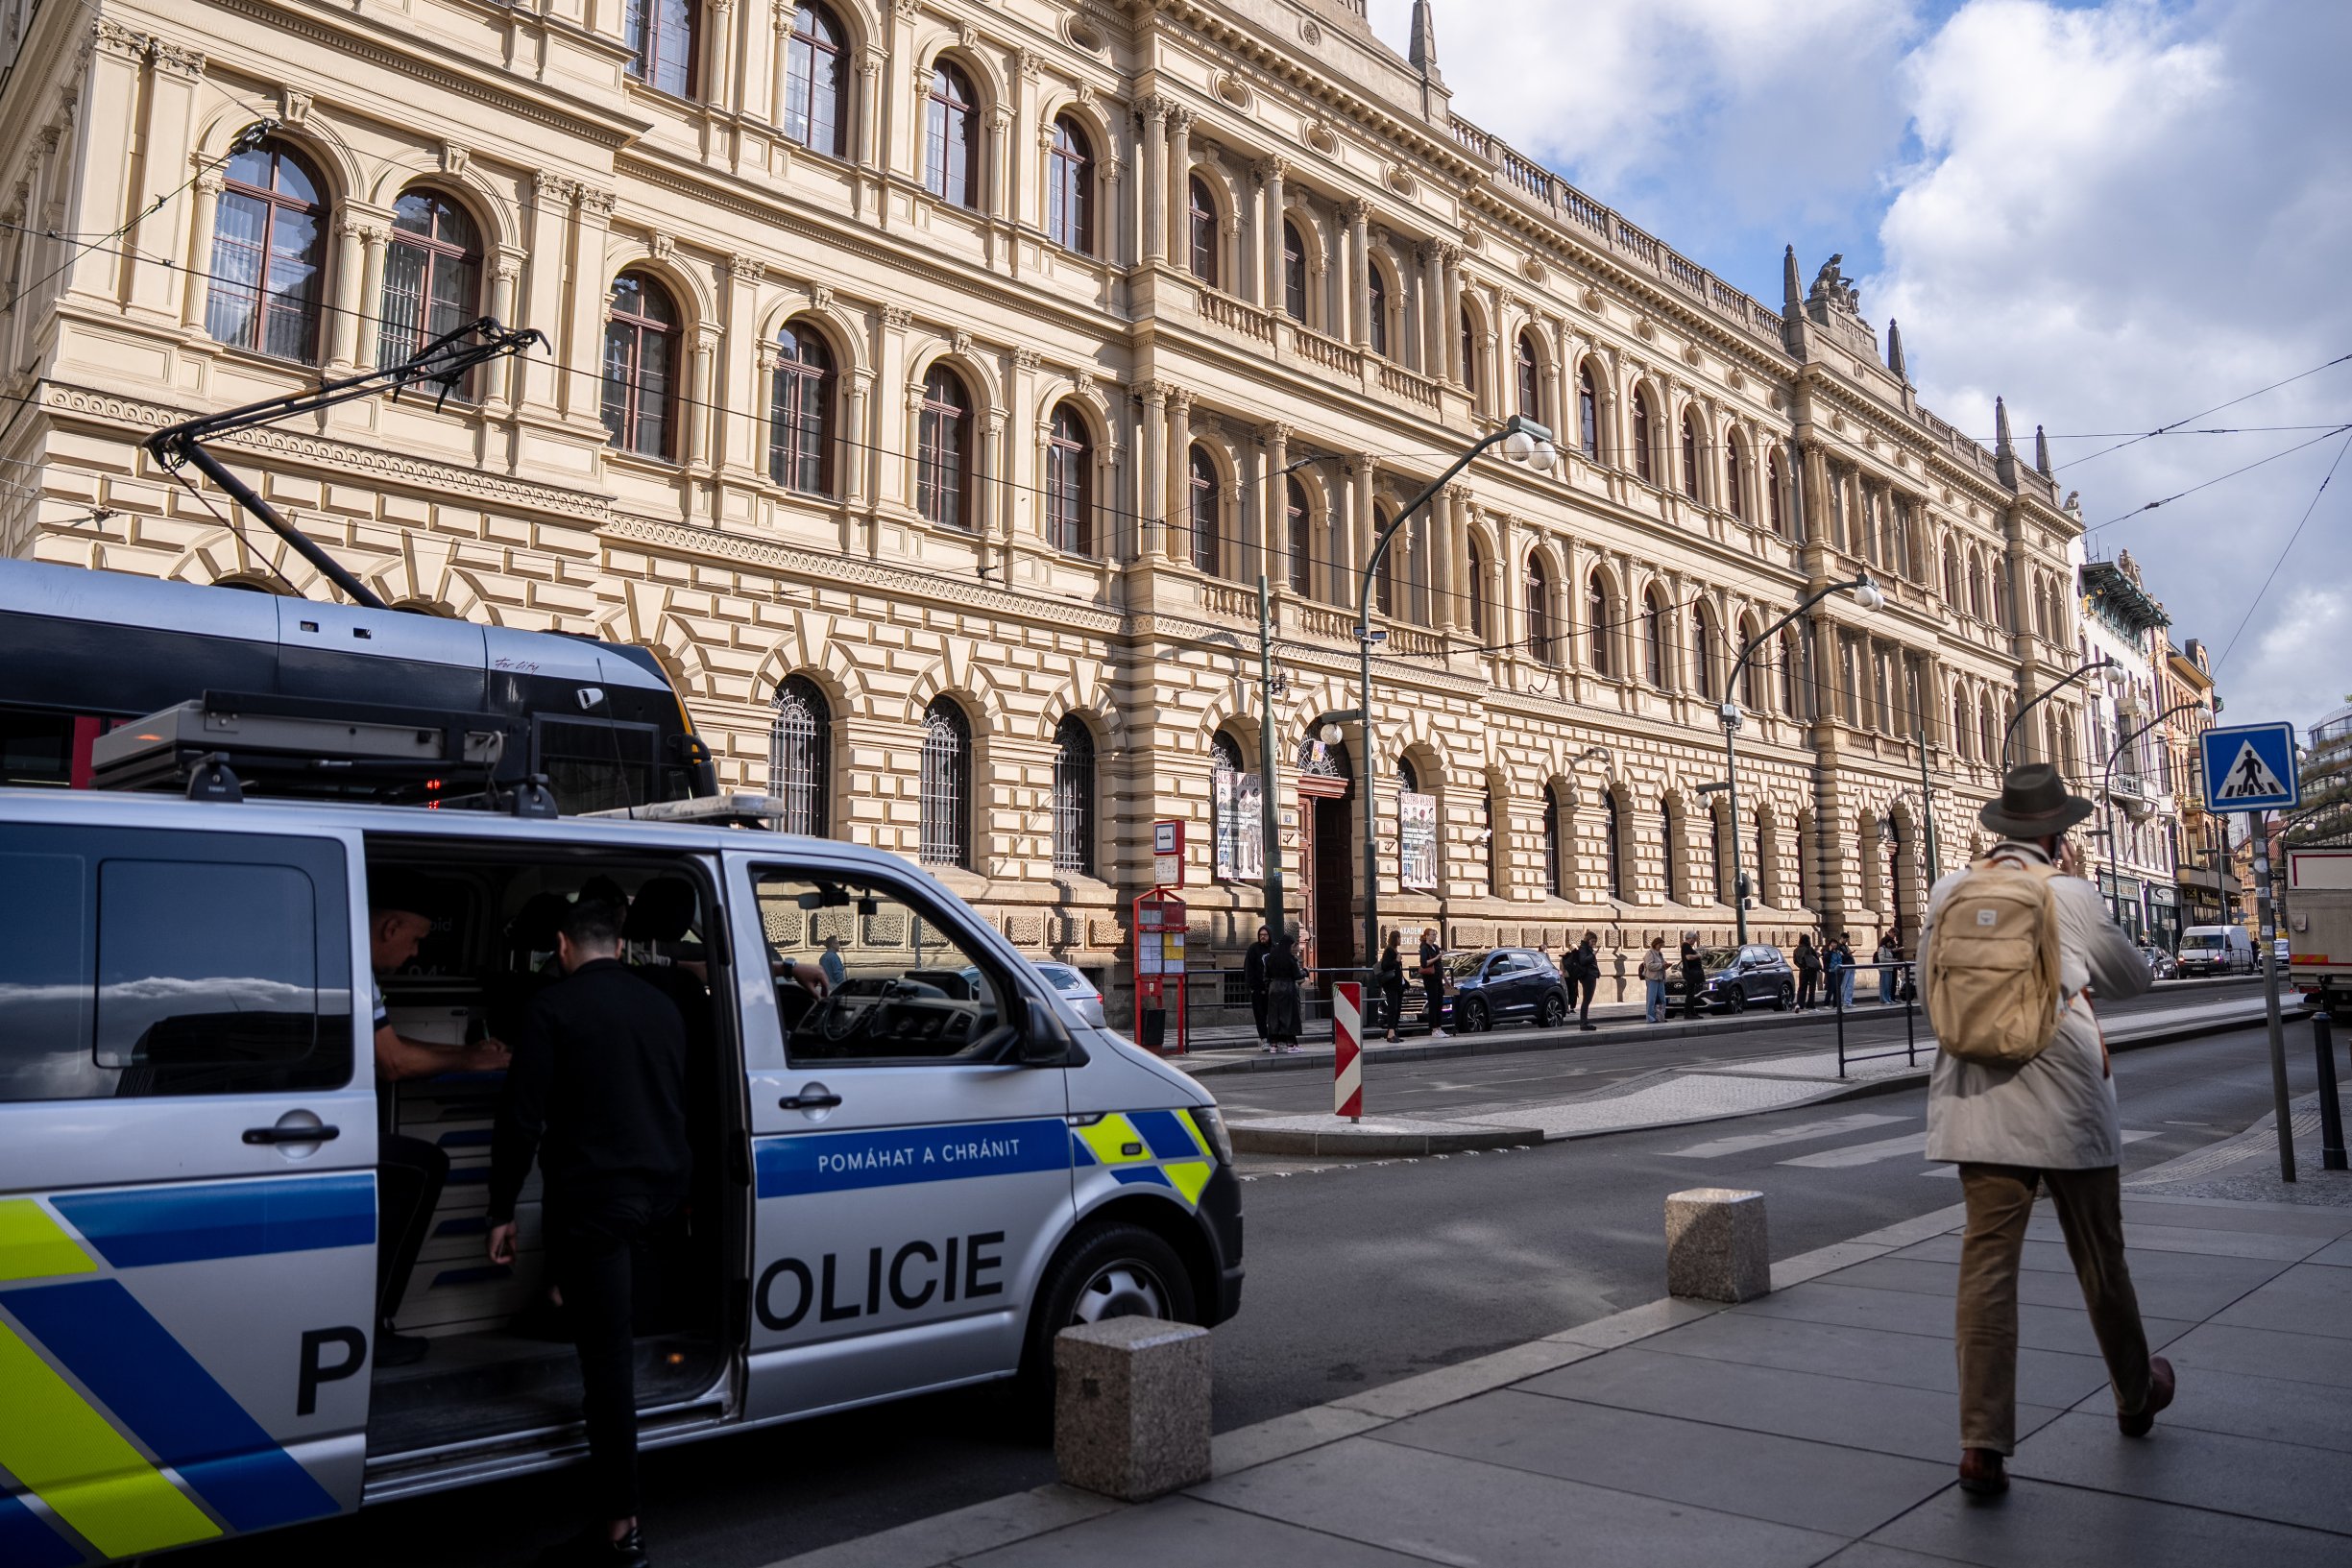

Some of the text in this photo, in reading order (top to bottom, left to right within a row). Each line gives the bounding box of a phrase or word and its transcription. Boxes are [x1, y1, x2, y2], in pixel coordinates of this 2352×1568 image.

[495, 658, 539, 675] For City
[1399, 927, 1424, 935] AKADEMI
[818, 1138, 1019, 1172] POMÁHAT A CHRÁNIT
[297, 1230, 1005, 1416] P OLICIE
